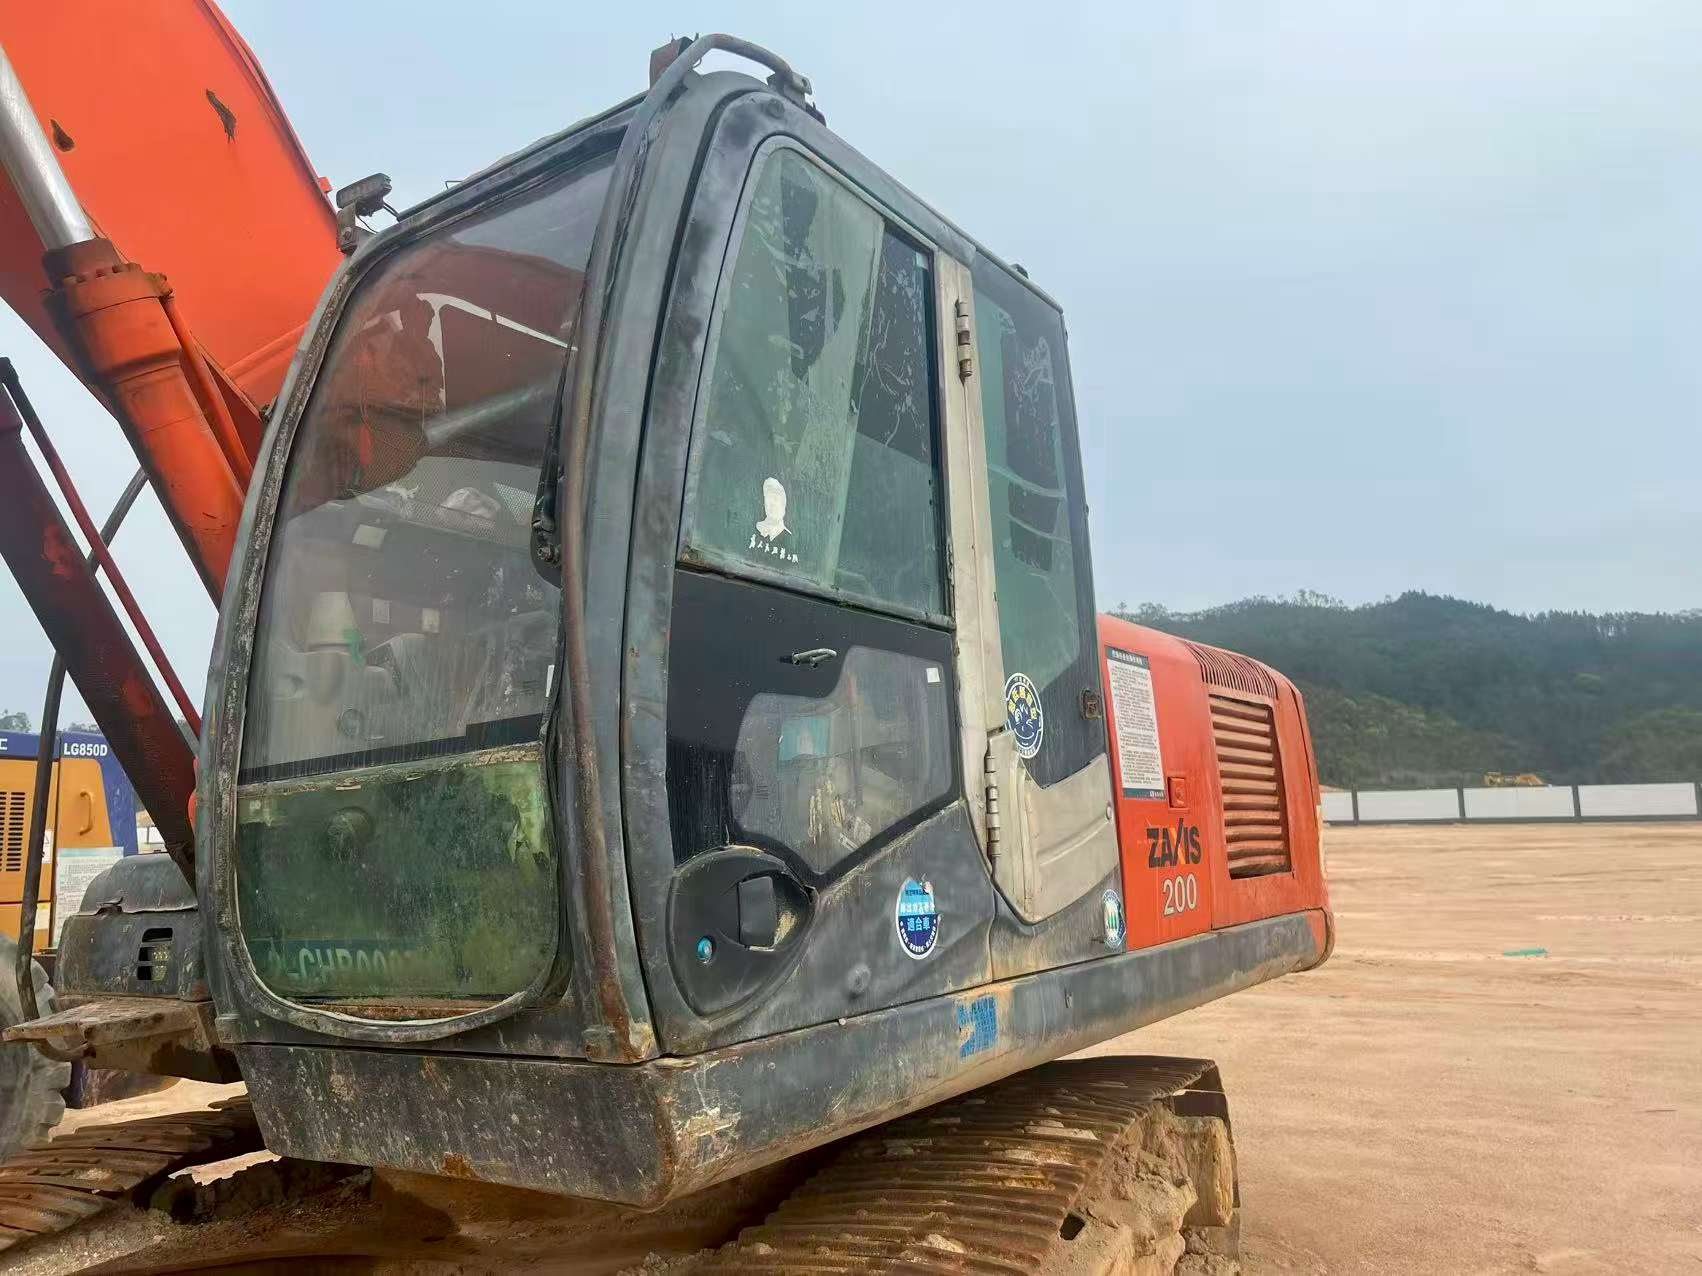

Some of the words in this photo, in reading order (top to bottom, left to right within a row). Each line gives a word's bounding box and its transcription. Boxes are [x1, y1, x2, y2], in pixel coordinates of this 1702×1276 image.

[63, 743, 108, 756] LG850D
[1146, 817, 1202, 868] ZAXIS
[1163, 873, 1197, 916] 200
